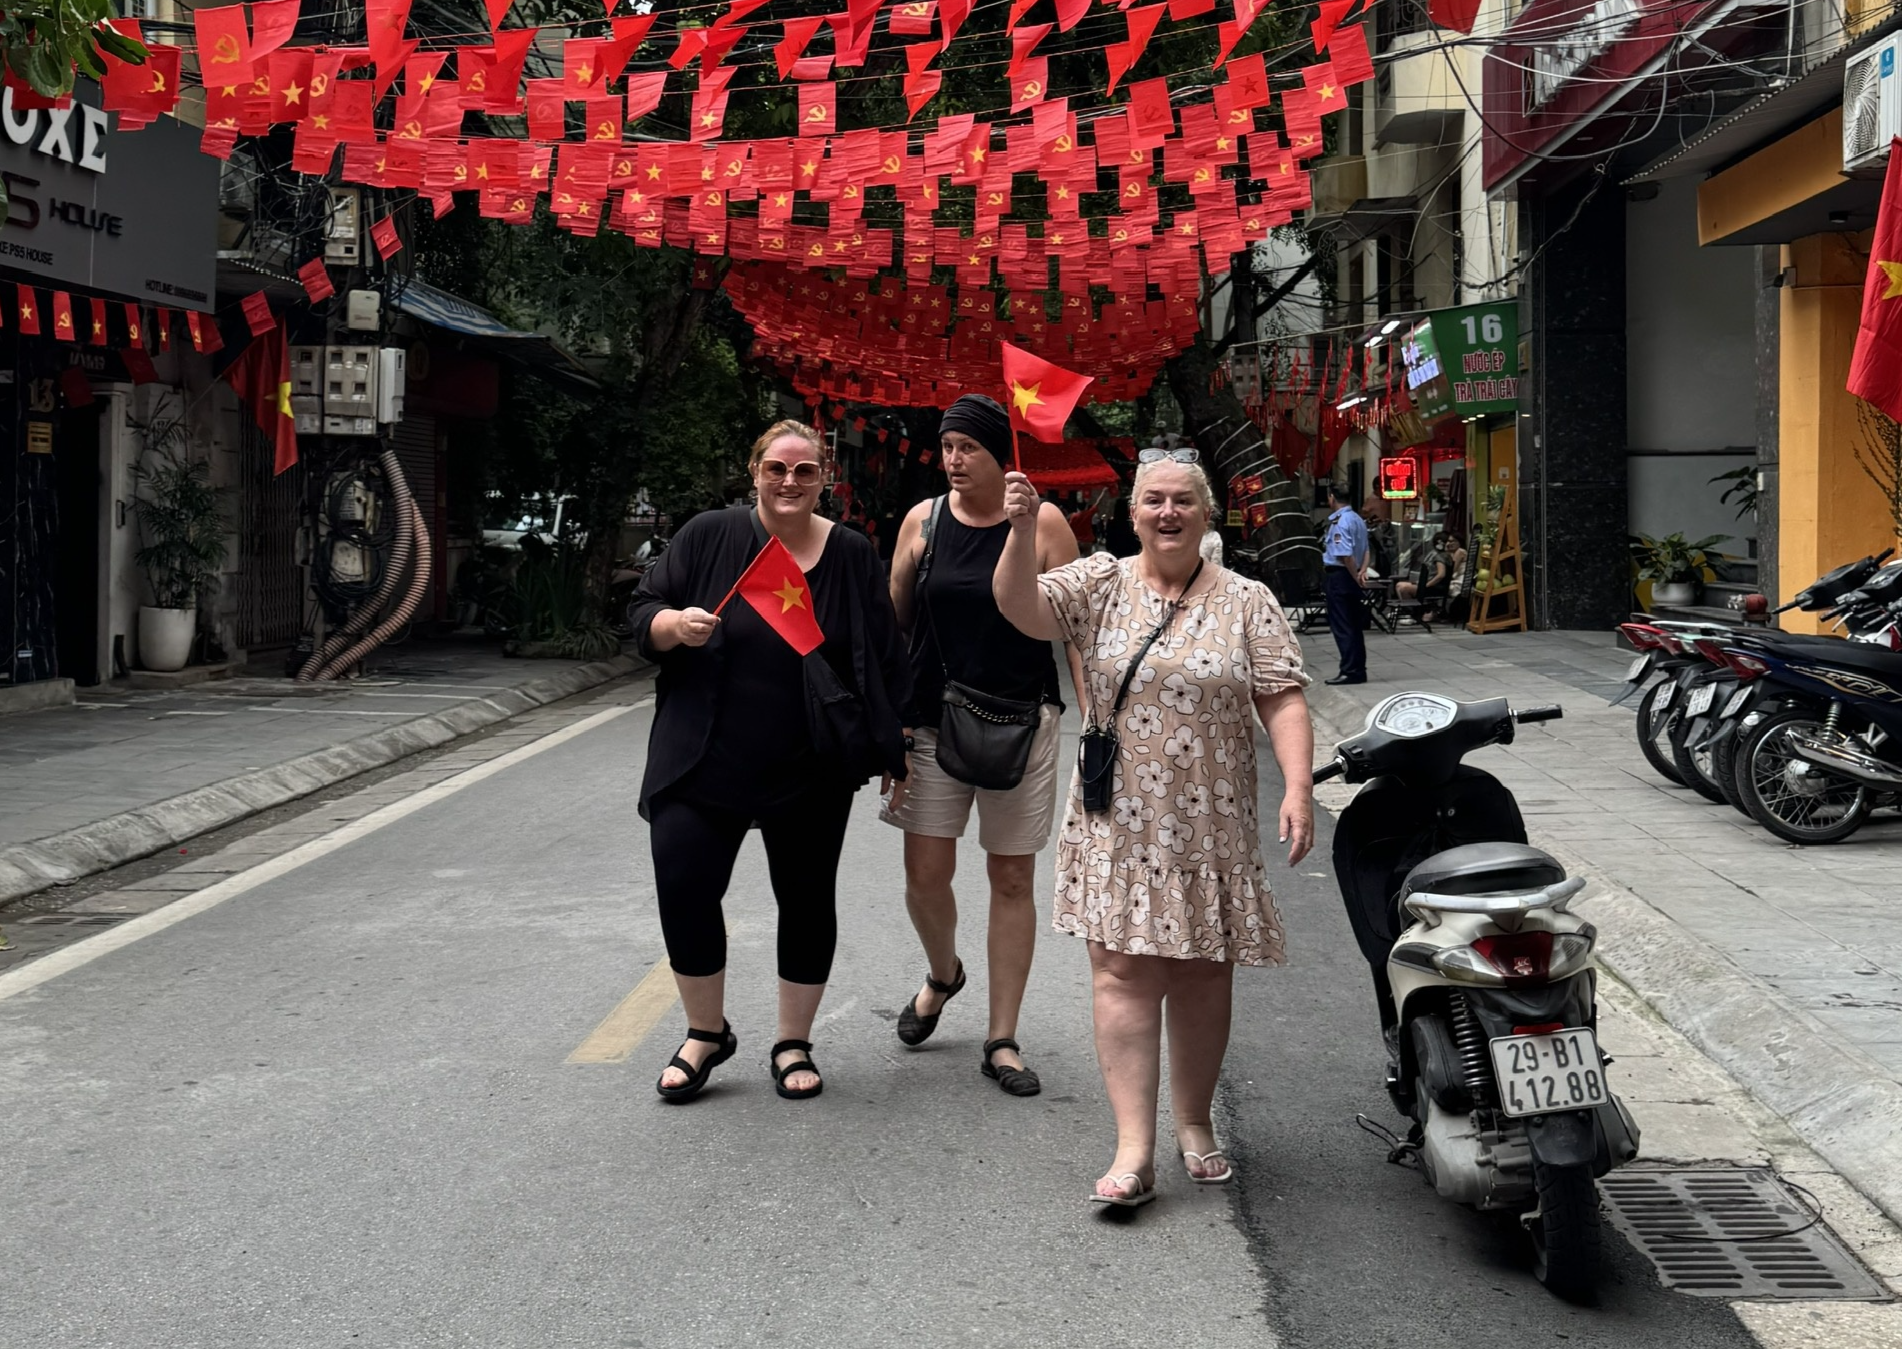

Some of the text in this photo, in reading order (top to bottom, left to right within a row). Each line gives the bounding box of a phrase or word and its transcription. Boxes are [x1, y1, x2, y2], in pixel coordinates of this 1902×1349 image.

[9, 243, 25, 258] PS5
[26, 247, 53, 265] HOUSE
[1460, 314, 1503, 345] 16
[1463, 349, 1491, 374] NƯỚC
[1491, 348, 1505, 372] ÉP
[28, 378, 55, 413] 13
[1454, 377, 1474, 402] TRÀ
[1474, 376, 1497, 401] TRÁI
[1507, 1035, 1584, 1074] 29-B1
[1509, 1069, 1602, 1111] 412.88
